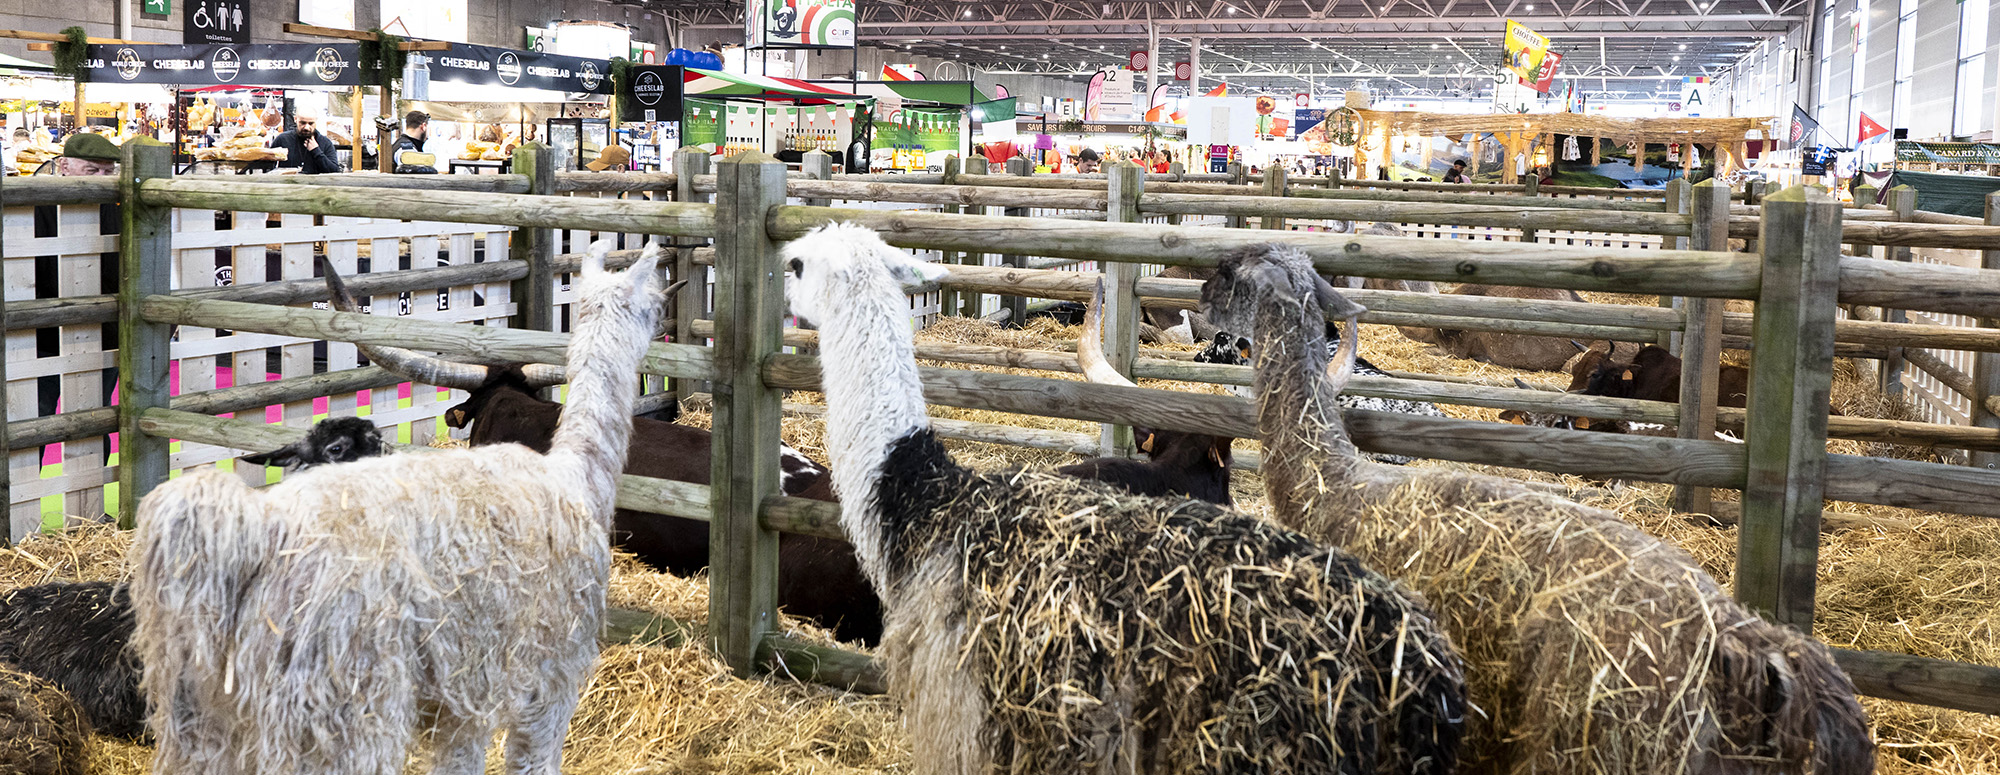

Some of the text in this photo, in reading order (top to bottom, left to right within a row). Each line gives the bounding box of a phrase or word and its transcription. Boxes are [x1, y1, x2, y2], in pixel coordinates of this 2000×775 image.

[205, 34, 232, 42] toilettes
[1513, 27, 1540, 46] CHOUFFE
[535, 36, 544, 52] 6
[153, 60, 205, 70] CHEESELAB
[247, 59, 301, 70] CHEESELAB
[440, 57, 490, 71] CHEESELAB
[527, 66, 570, 78] CHEESELAB
[1494, 70, 1513, 84] 5.1
[1687, 89, 1702, 105] A
[1063, 105, 1070, 115] E
[221, 271, 231, 279] TH
